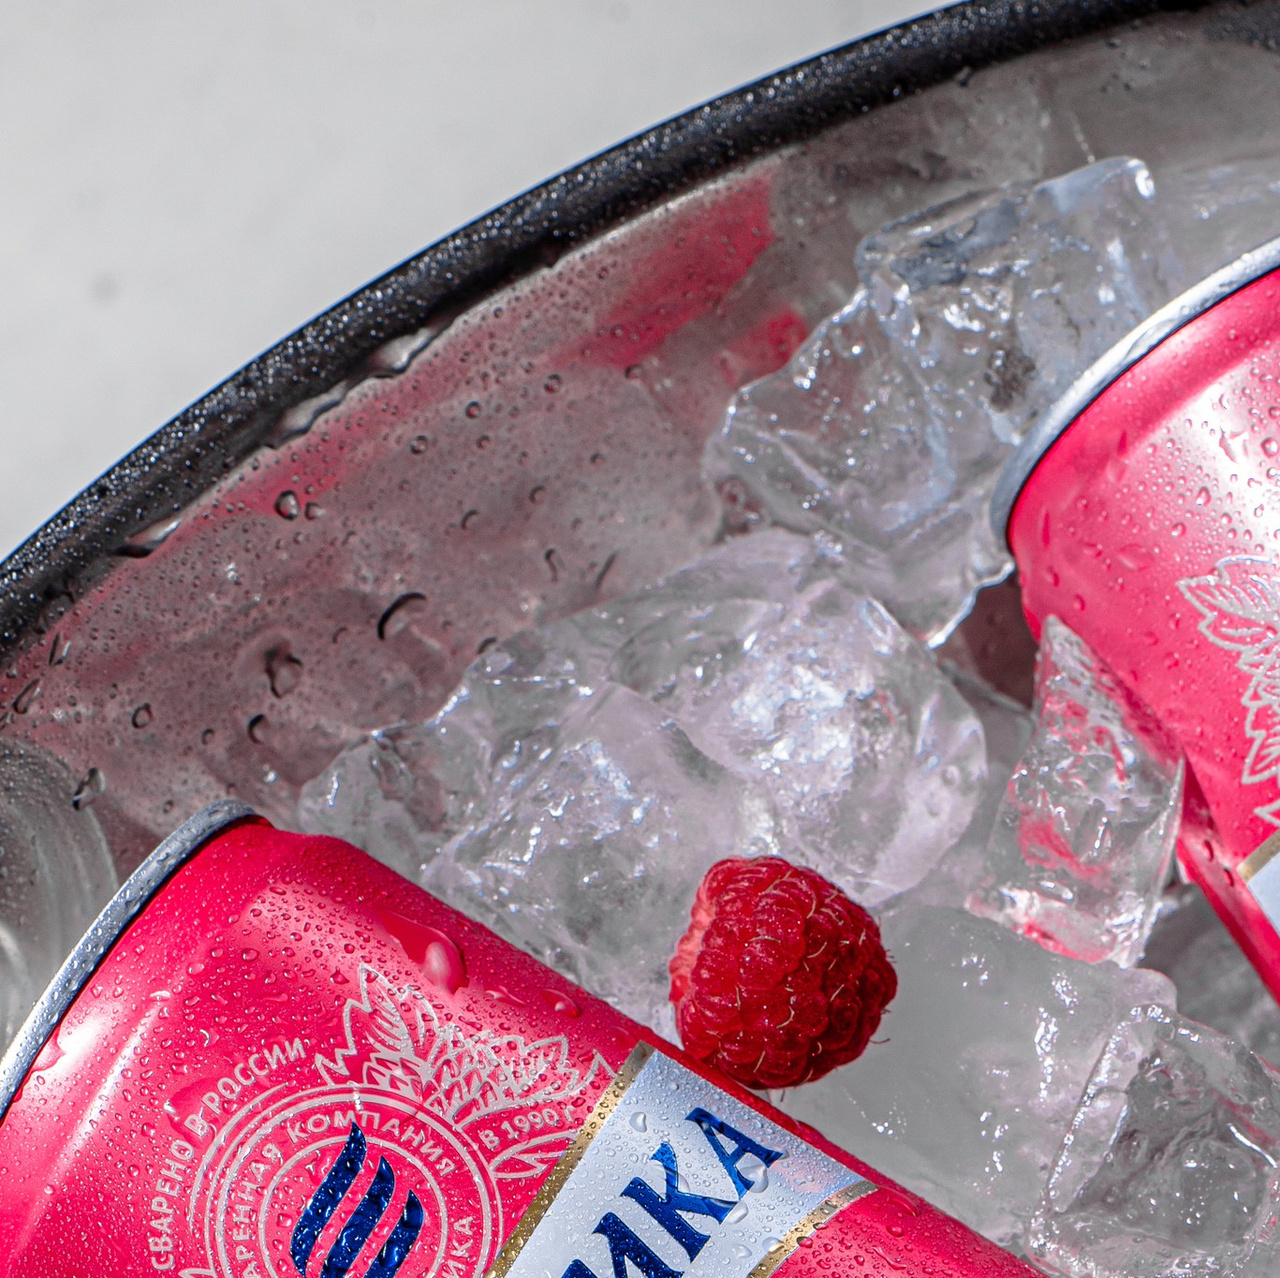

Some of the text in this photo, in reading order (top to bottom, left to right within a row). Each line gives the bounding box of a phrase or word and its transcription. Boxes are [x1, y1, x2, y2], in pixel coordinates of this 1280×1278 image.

[150, 1036, 309, 1271] СВАРЕНО В РОССИИ
[286, 1109, 457, 1177] КОМПАНИЯ
[478, 1129, 501, 1153] В
[501, 1108, 560, 1140] 1990
